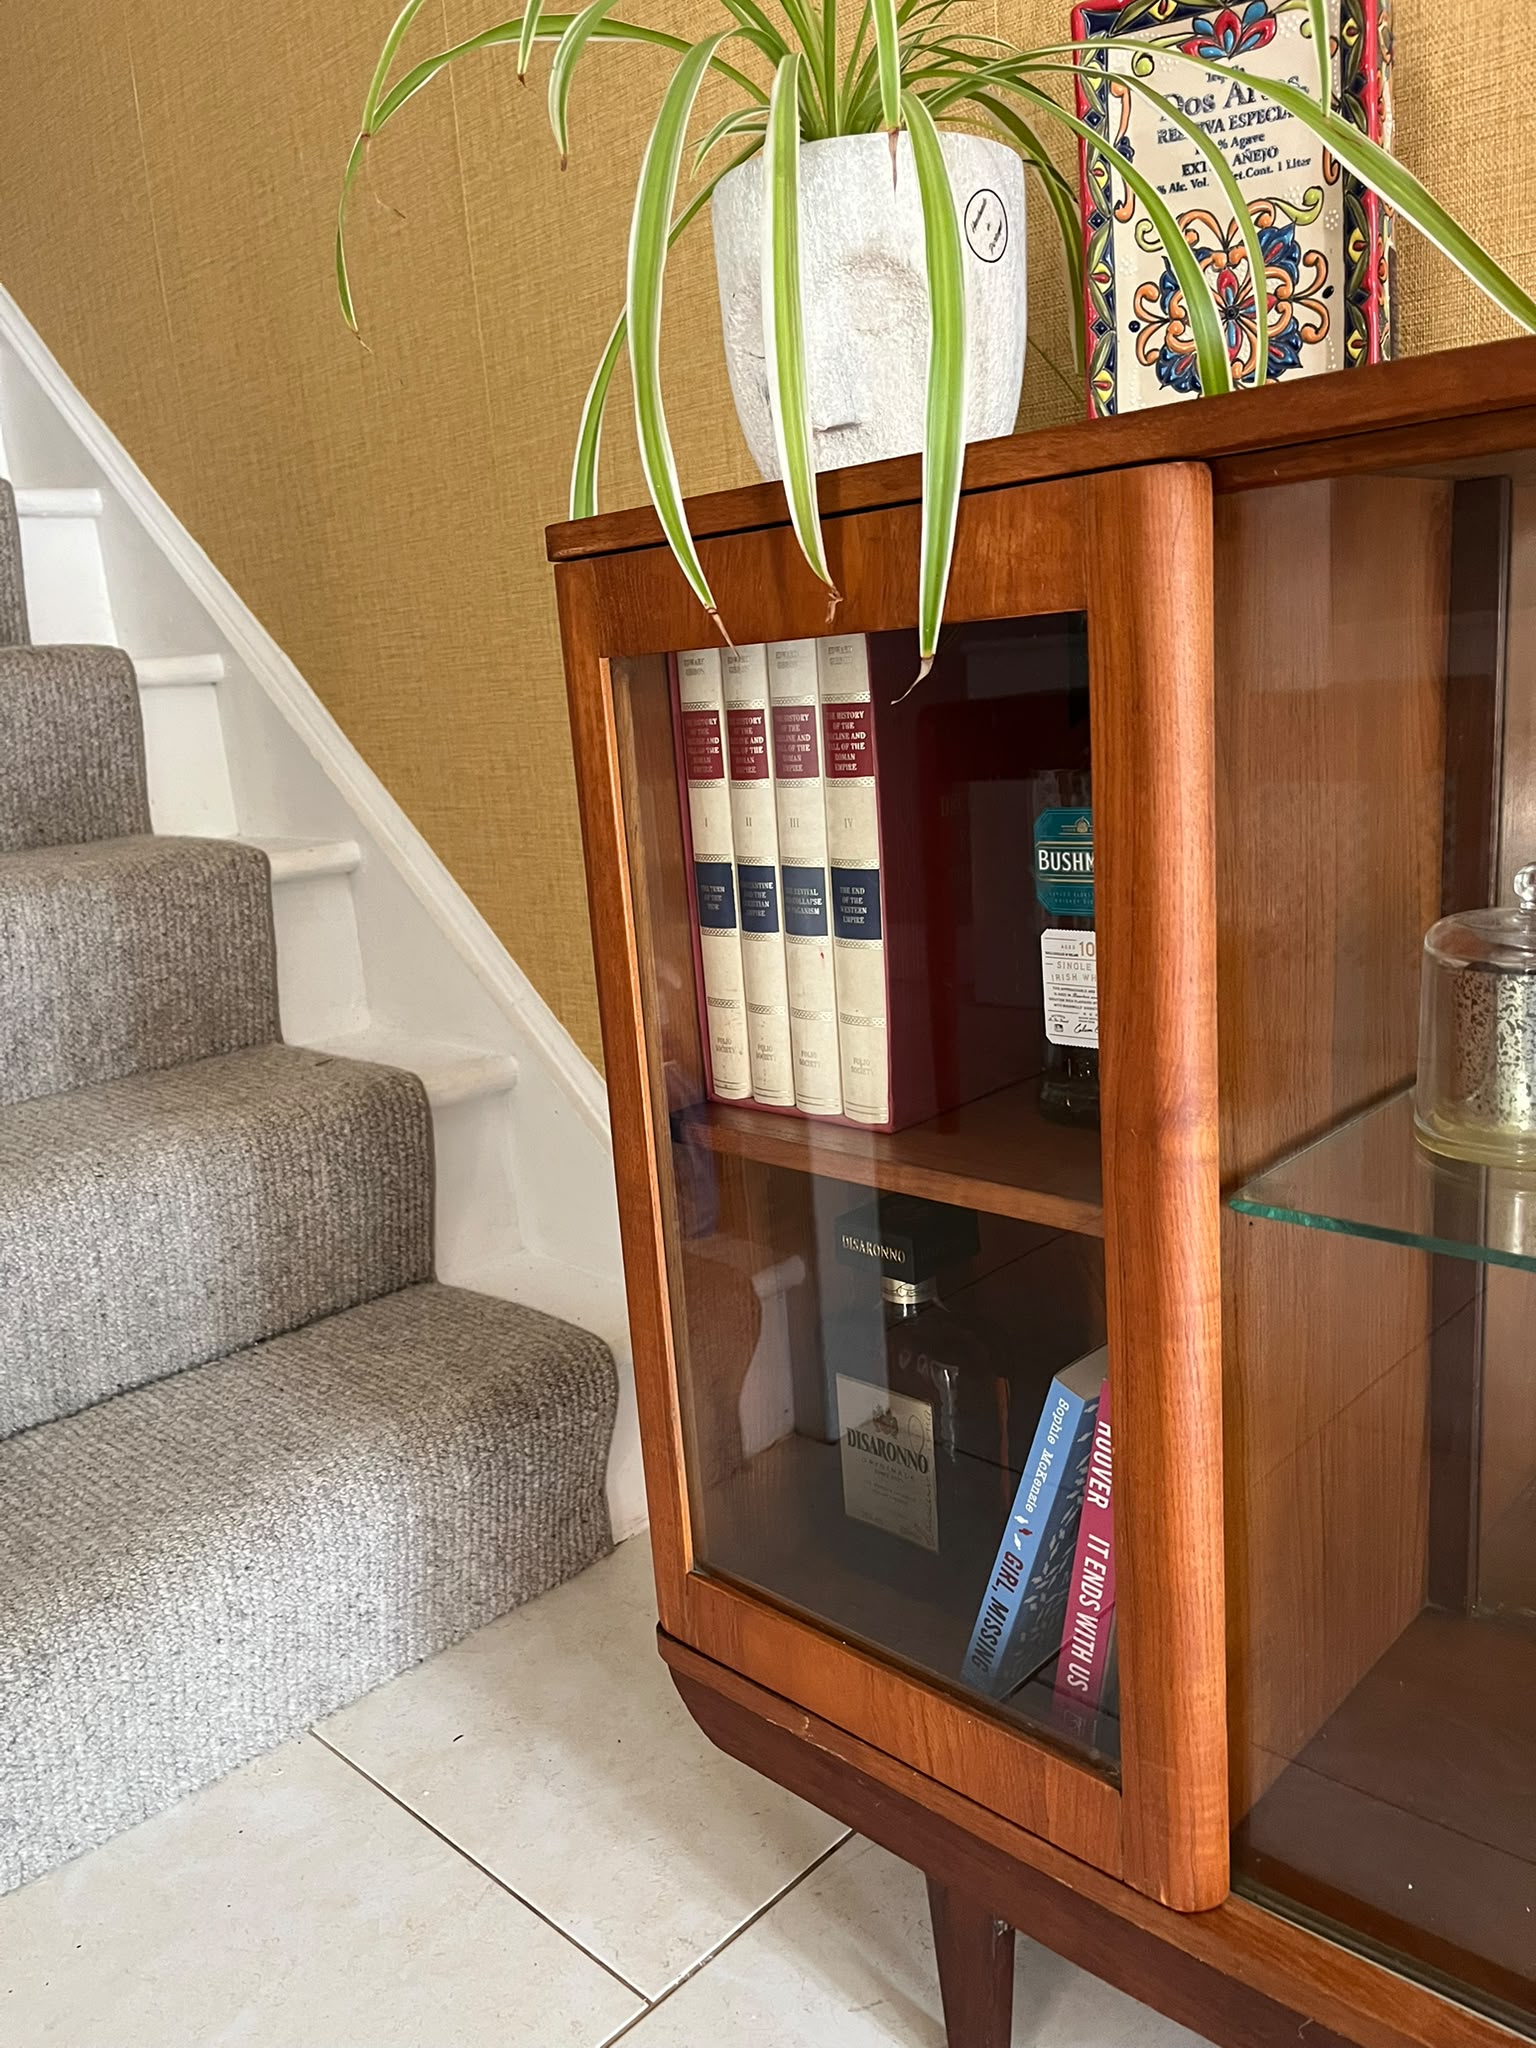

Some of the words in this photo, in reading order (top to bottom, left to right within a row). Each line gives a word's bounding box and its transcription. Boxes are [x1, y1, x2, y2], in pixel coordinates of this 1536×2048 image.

[1157, 119, 1226, 144] RESRVA
[1228, 105, 1295, 131] ESPECIA
[1230, 133, 1265, 149] Agave
[1182, 161, 1211, 177] EXT
[1232, 145, 1279, 167] AÑEJO
[1169, 182, 1188, 194] Alc.
[1190, 178, 1209, 189] Vol.
[1232, 166, 1273, 181] et.Cont.
[1286, 158, 1312, 169] Liter
[836, 711, 864, 720] HISTORY
[797, 744, 811, 752] THE
[850, 742, 866, 750] THE
[851, 732, 866, 740] AND
[746, 817, 752, 827] II
[790, 818, 800, 828] III
[844, 817, 854, 829] IV
[1079, 941, 1095, 957] 10
[1051, 973, 1078, 982] IRISH
[1056, 960, 1092, 971] SINGLE
[842, 1235, 906, 1264] DISARONNO
[1047, 1398, 1070, 1445] Sophie
[847, 1427, 928, 1474] DISARONNO
[1025, 1448, 1054, 1513] McKenzie
[1087, 1533, 1111, 1560] IT
[991, 1551, 1024, 1593] GIRL,
[1079, 1556, 1107, 1612] ENDS
[971, 1596, 1009, 1673] MISSING
[1070, 1612, 1099, 1664] WITH
[1067, 1663, 1091, 1692] US
